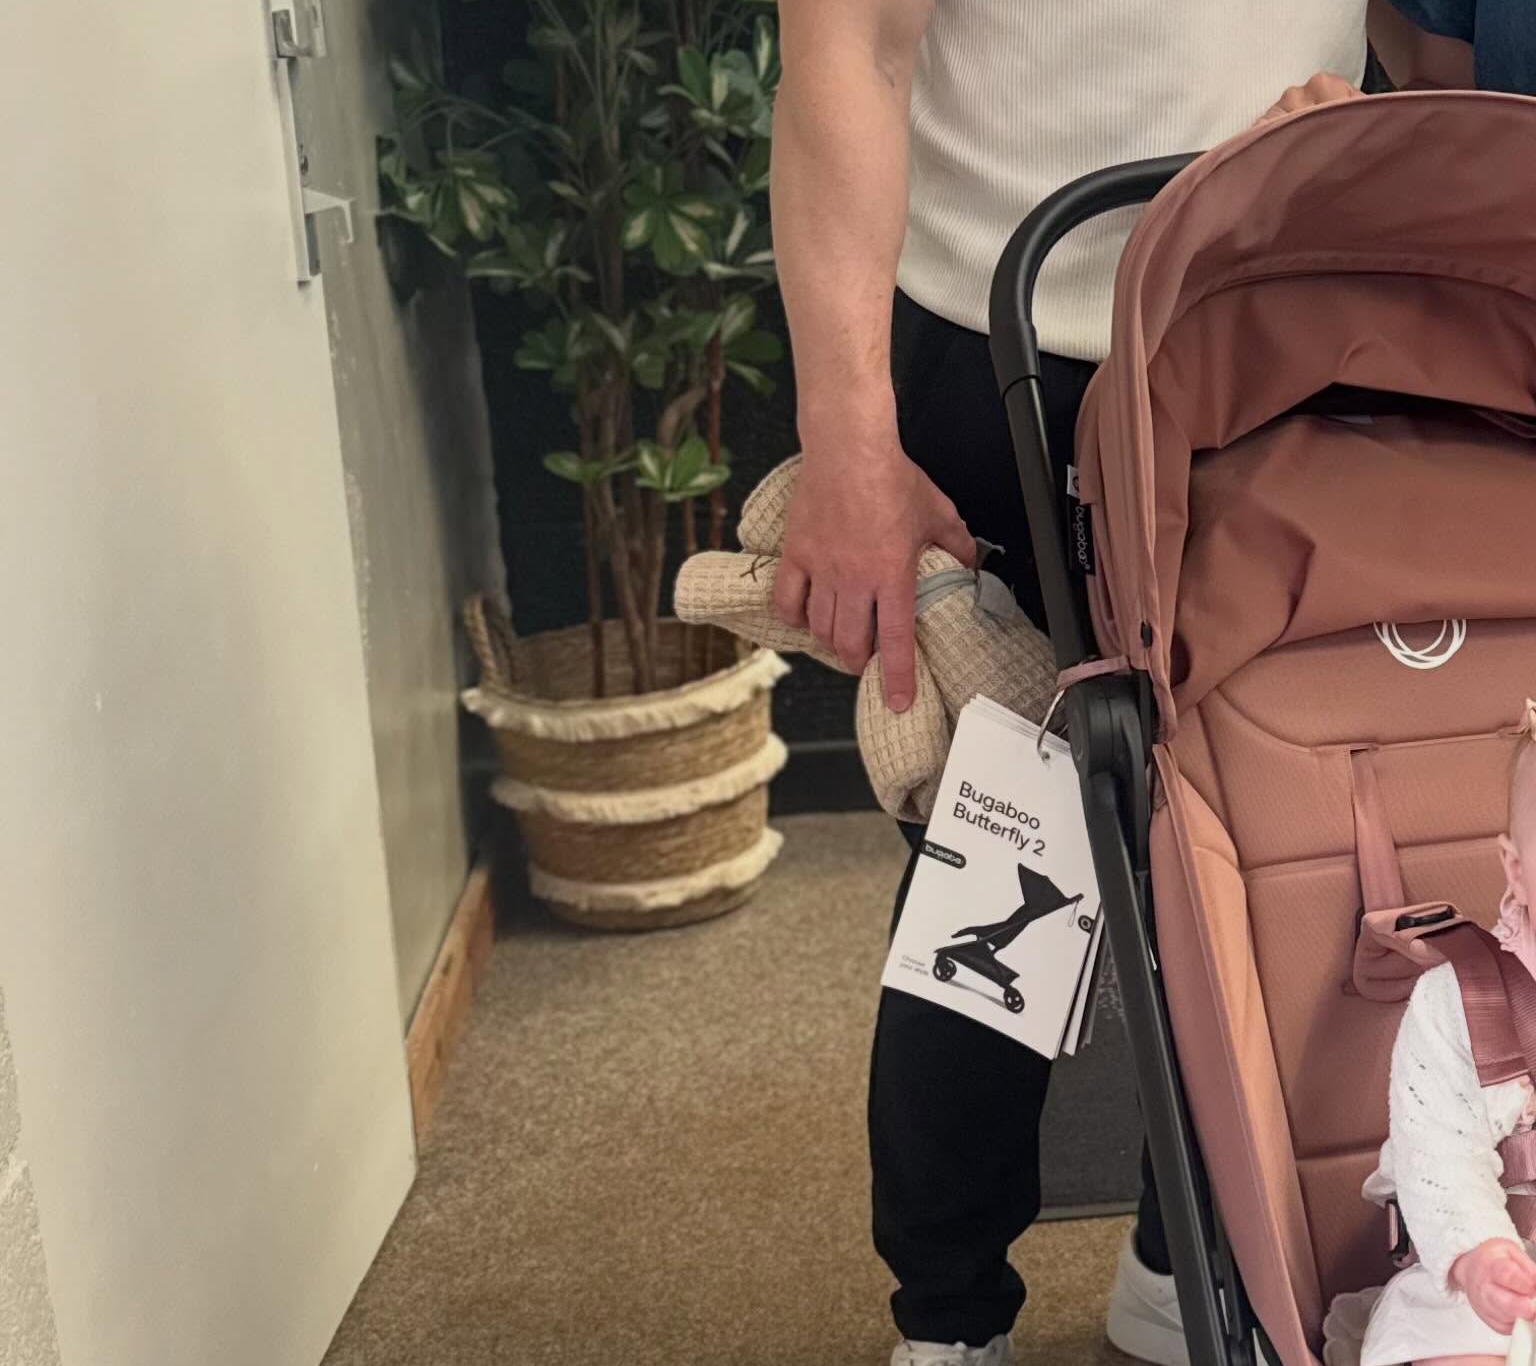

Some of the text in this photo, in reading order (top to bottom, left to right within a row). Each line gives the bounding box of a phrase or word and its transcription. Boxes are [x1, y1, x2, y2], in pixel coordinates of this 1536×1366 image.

[953, 801, 1046, 857] Butterfly 2
[959, 780, 1040, 830] Bugaboo
